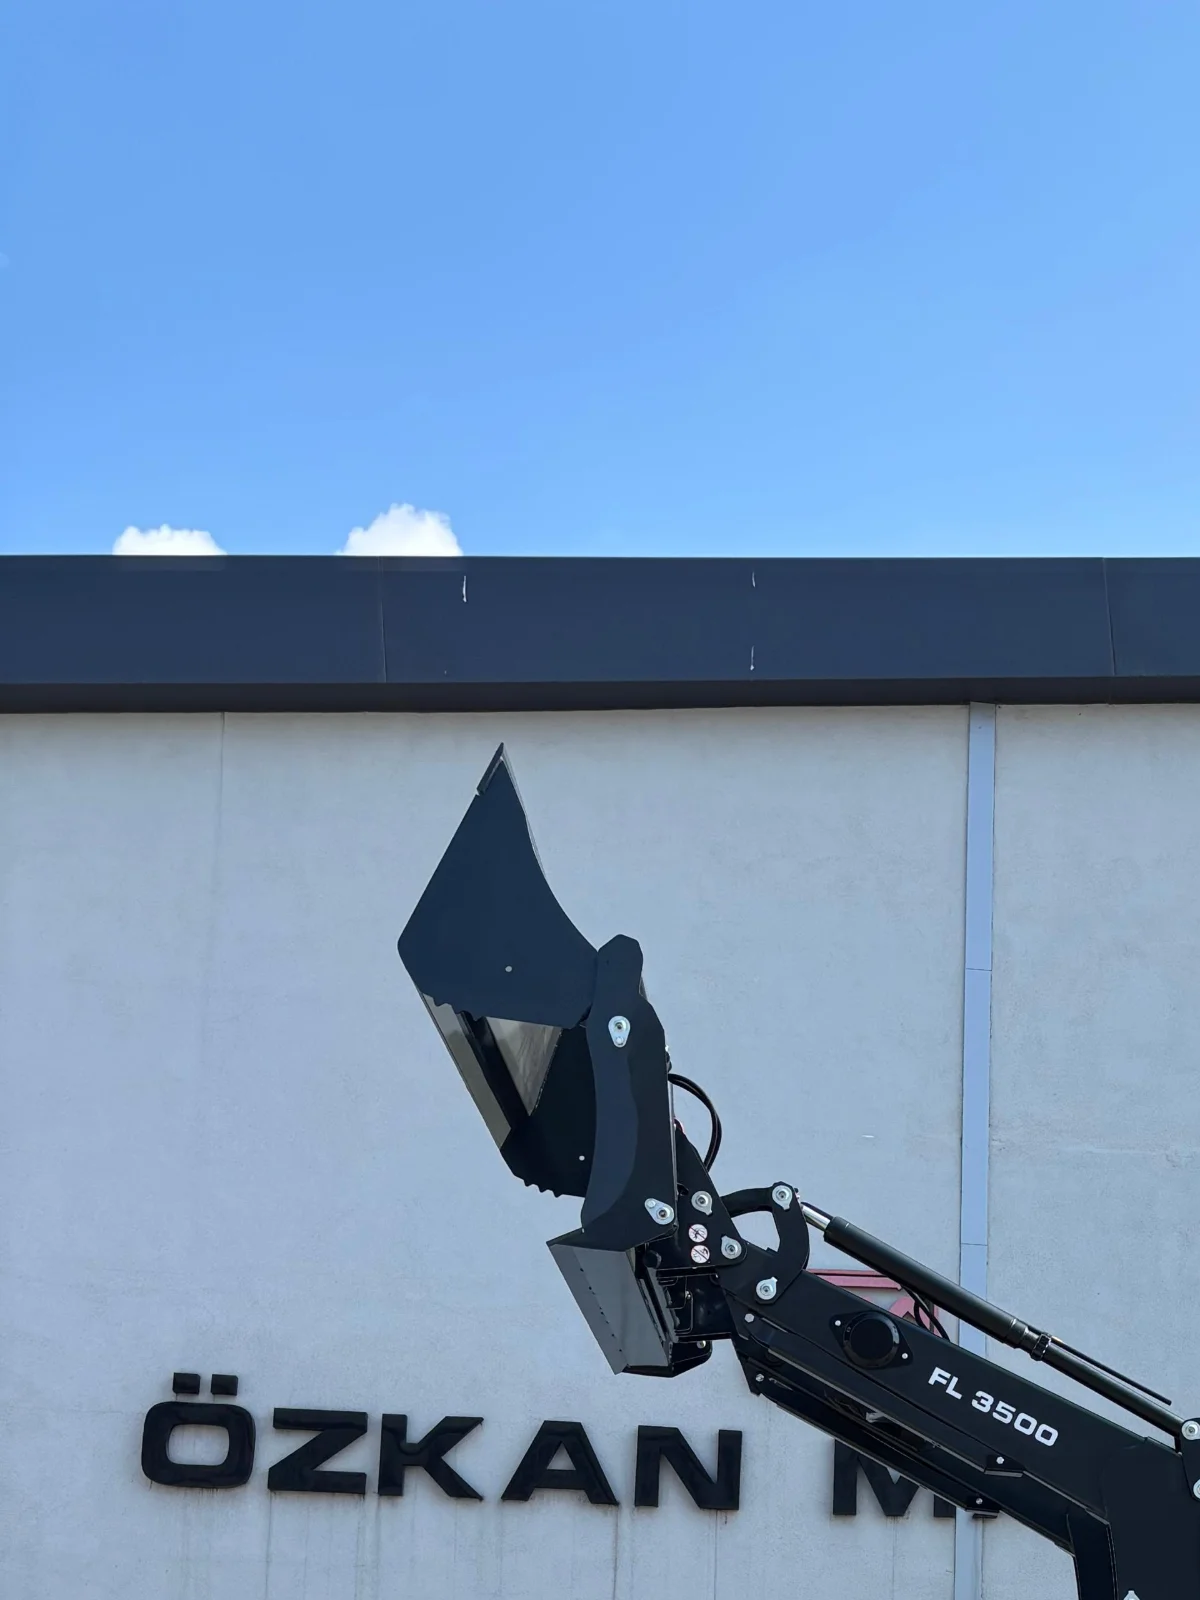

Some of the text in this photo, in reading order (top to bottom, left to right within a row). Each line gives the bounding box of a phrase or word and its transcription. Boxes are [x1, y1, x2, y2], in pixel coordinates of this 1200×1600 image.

[141, 1372, 743, 1511] ÖZKAN
[928, 1366, 1059, 1447] FL 3500
